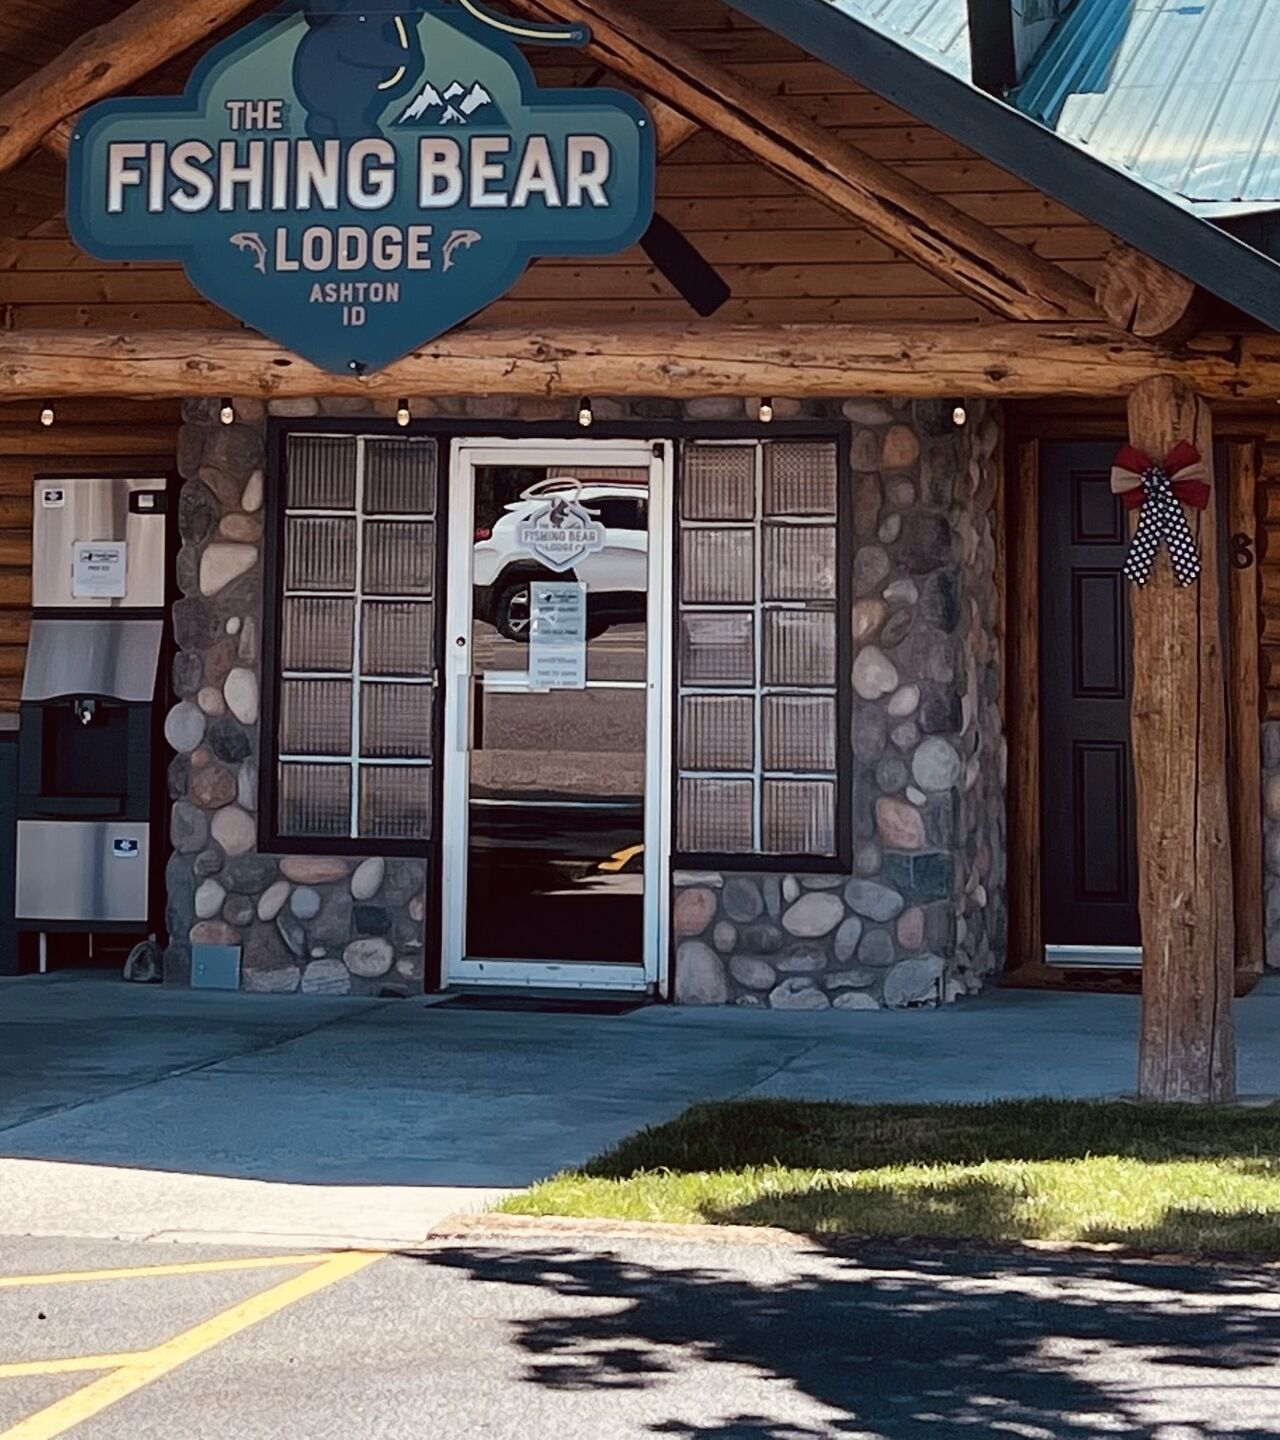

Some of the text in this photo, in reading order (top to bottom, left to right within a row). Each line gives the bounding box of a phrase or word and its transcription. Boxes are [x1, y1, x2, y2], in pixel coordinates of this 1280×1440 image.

[227, 100, 283, 130] THE
[107, 135, 611, 213] FISHING BEAR
[275, 226, 432, 271] LODGE
[309, 282, 400, 304] ASHTON
[342, 306, 366, 326] ID
[523, 530, 596, 541] FISHING BEAR
